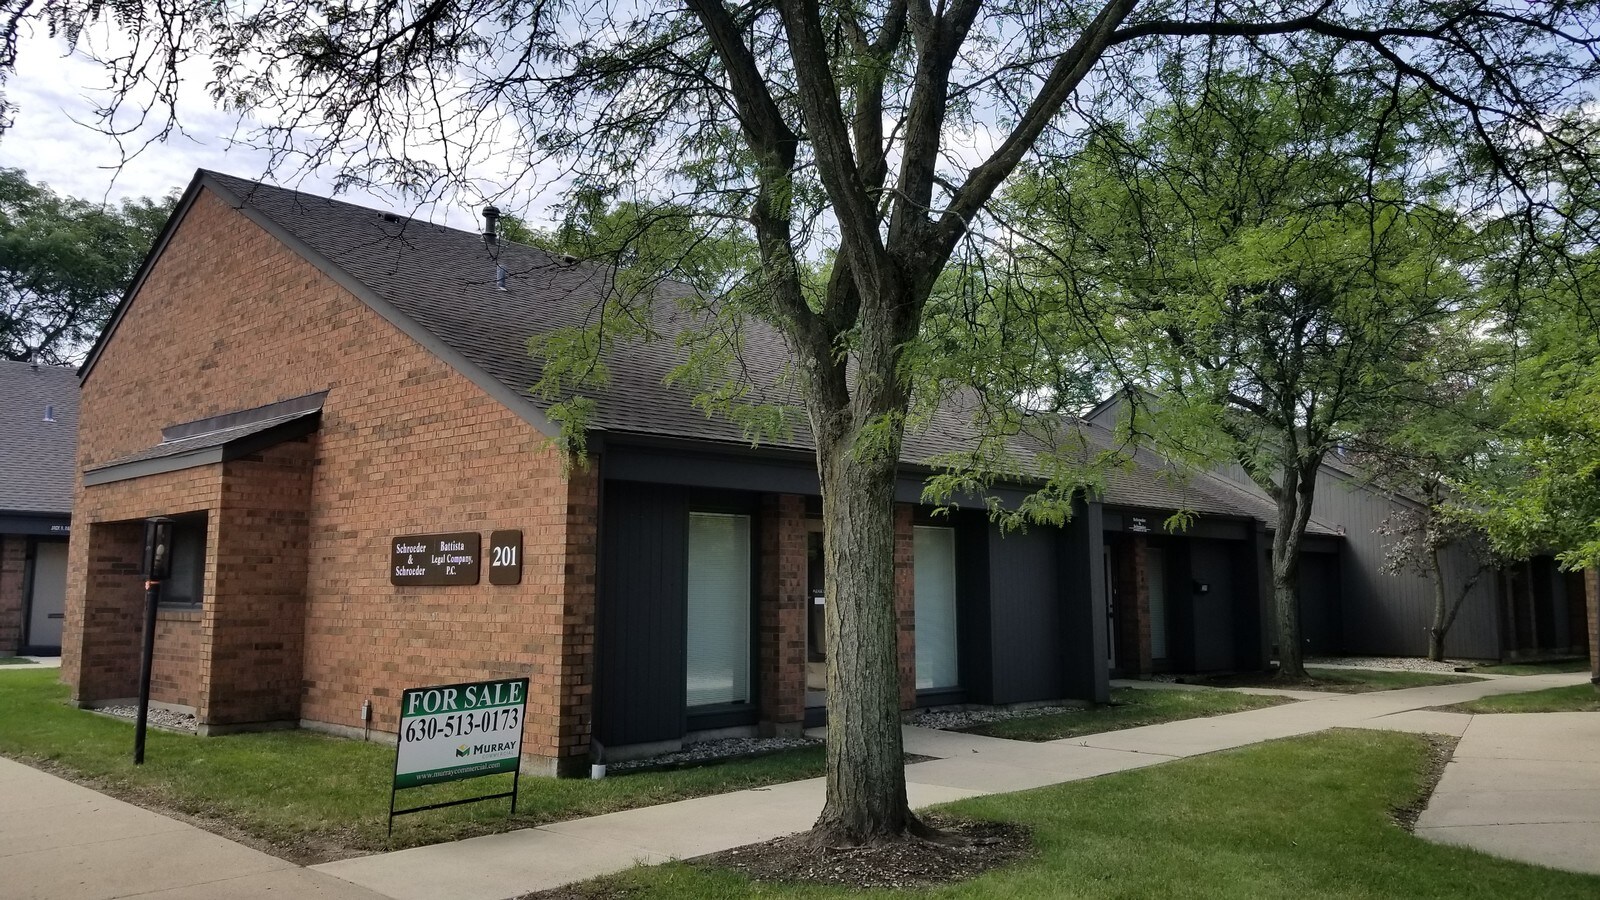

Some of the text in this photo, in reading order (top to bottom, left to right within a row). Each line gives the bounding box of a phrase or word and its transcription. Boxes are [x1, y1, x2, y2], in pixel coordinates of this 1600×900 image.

[396, 543, 426, 554] Schroeder
[440, 541, 464, 552] Battista
[407, 554, 414, 564] &
[431, 554, 473, 566] Legal Company,
[492, 546, 516, 567] 201
[395, 566, 426, 576] Schroeder
[446, 566, 457, 575] P.C.
[407, 681, 523, 715] FOR SALE
[405, 707, 518, 743] 630-513-0173
[473, 741, 516, 755] MURRAY
[416, 762, 501, 780] www.murraycommercial.com
